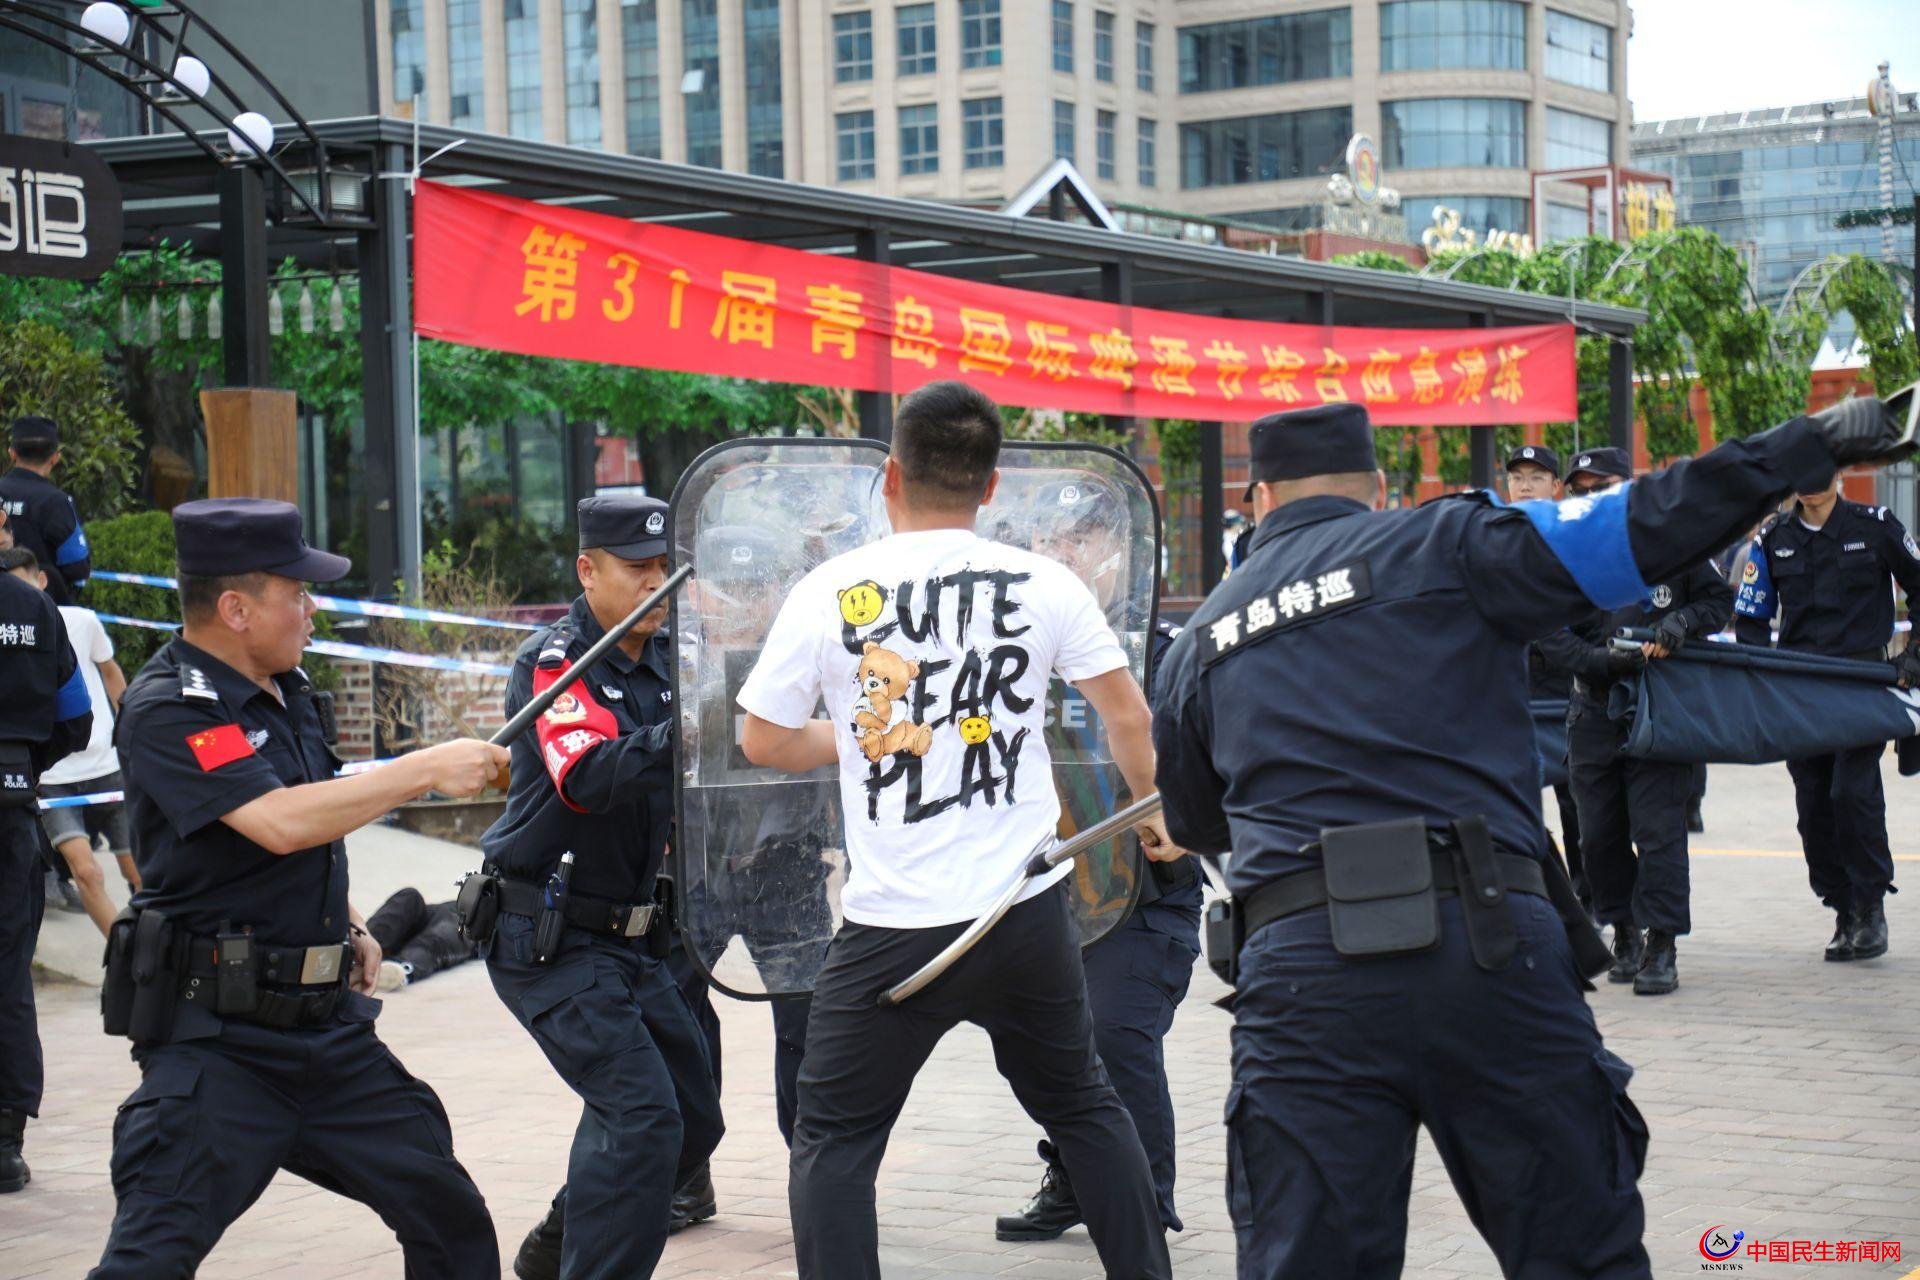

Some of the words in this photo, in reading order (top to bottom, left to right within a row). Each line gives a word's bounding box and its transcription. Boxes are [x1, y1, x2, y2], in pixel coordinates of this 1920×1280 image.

[515, 225, 1529, 405] 第31届青岛国际啤酒节综合应急演练
[1210, 568, 1355, 651] 青岛特巡
[855, 645, 1034, 729] EAR
[4, 781, 28, 789] POLICE
[862, 726, 1030, 824] PLAY
